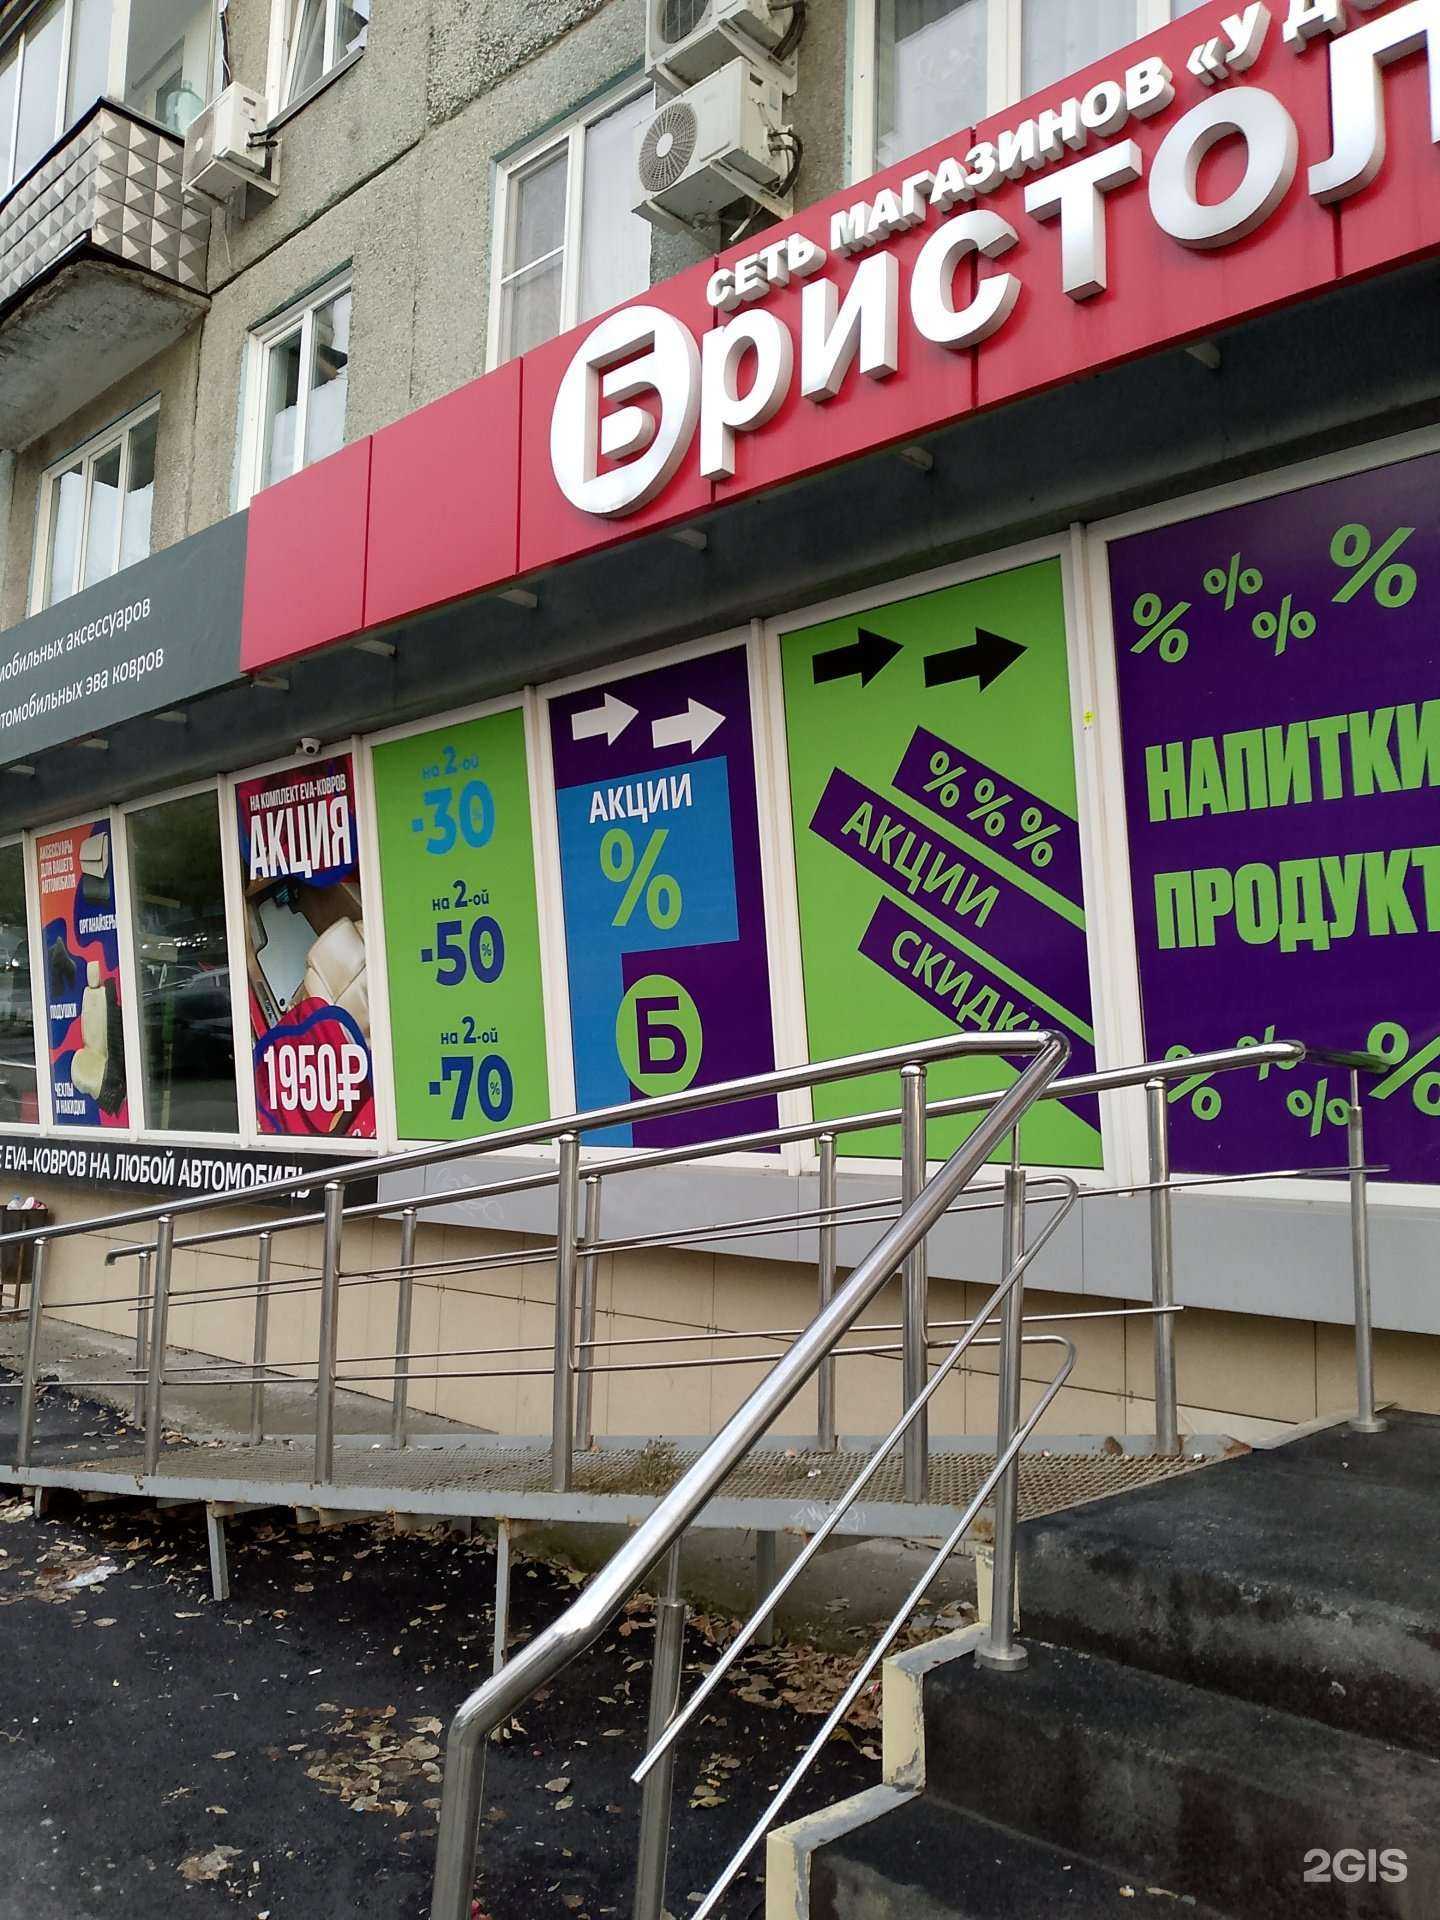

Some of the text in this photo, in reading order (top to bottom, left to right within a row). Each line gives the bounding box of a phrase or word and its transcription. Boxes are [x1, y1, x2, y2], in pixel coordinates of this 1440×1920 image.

[706, 233, 826, 310] СЕТЬ
[830, 56, 1175, 255] МАГАЗИНОВ
[66, 598, 151, 651] аксессуаров
[0, 648, 164, 729] томобильных эва ковров
[422, 765, 440, 779] на
[1145, 698, 1440, 822] НАПИТКИ
[250, 774, 346, 812] НА КОМПЛЕКТ EVA-КОВРОВ
[589, 773, 692, 823] АКЦИИ
[250, 796, 352, 880] АКЦИЯ
[841, 800, 999, 929] АКЦИИ
[432, 897, 449, 912] на
[891, 930, 1040, 1032] СКИДК
[441, 1032, 458, 1045] на
[635, 996, 688, 1075] Б
[54, 1082, 74, 1098] ЧЕХЛЫ
[5, 1145, 87, 1177] EVA-КОВРОВ
[89, 1152, 111, 1180] НА
[113, 1150, 175, 1186] ЛЮБОЙ
